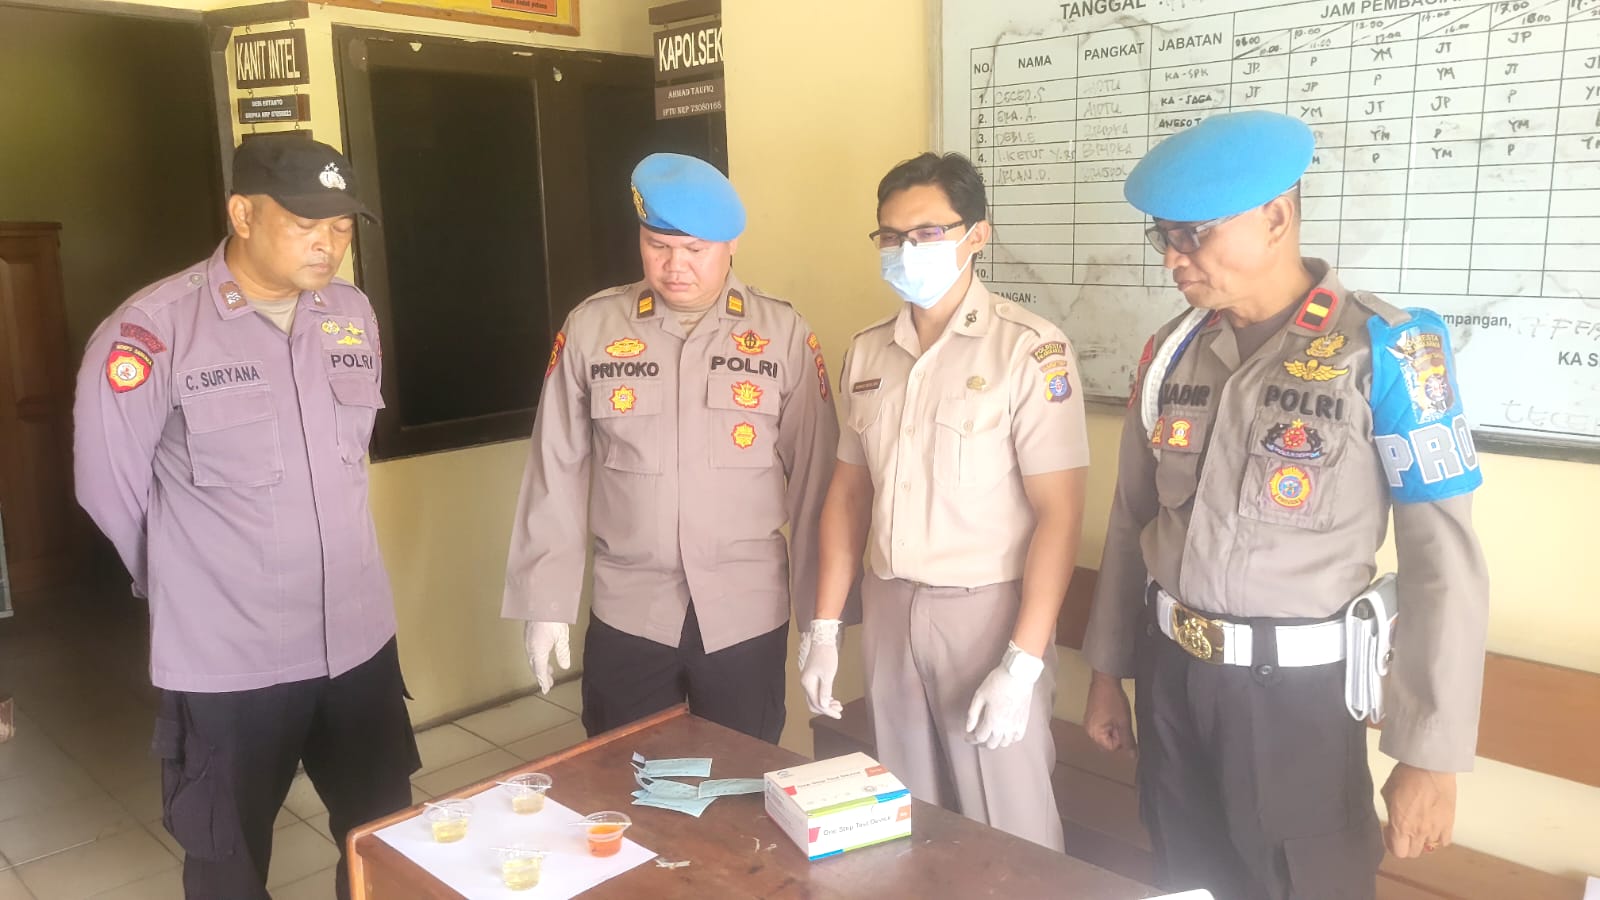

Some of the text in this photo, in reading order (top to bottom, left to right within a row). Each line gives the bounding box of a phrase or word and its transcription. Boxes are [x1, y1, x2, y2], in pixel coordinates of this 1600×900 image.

[1321, 3, 1355, 19] JAM
[1158, 32, 1223, 52] JABATAN
[1507, 31, 1533, 44] JP
[658, 27, 724, 72] KAPOLSEK
[1084, 42, 1146, 61] PANGKAT
[236, 37, 300, 80] KANIT INTEL
[1018, 54, 1053, 69] NAMA
[1310, 56, 1318, 67] P
[1373, 74, 1382, 86] P
[1431, 95, 1452, 111] JP
[1300, 105, 1323, 118] YM
[1508, 118, 1530, 133] YM
[1372, 152, 1381, 163] P
[1432, 147, 1453, 159] YM
[1508, 144, 1516, 156] P
[330, 353, 374, 369] POLRI
[711, 355, 778, 378] POLRI
[1558, 350, 1600, 367] KA S
[186, 365, 260, 391] C. SURYANA
[591, 361, 660, 380] PRIYOKO
[1263, 384, 1345, 420] POLRI
